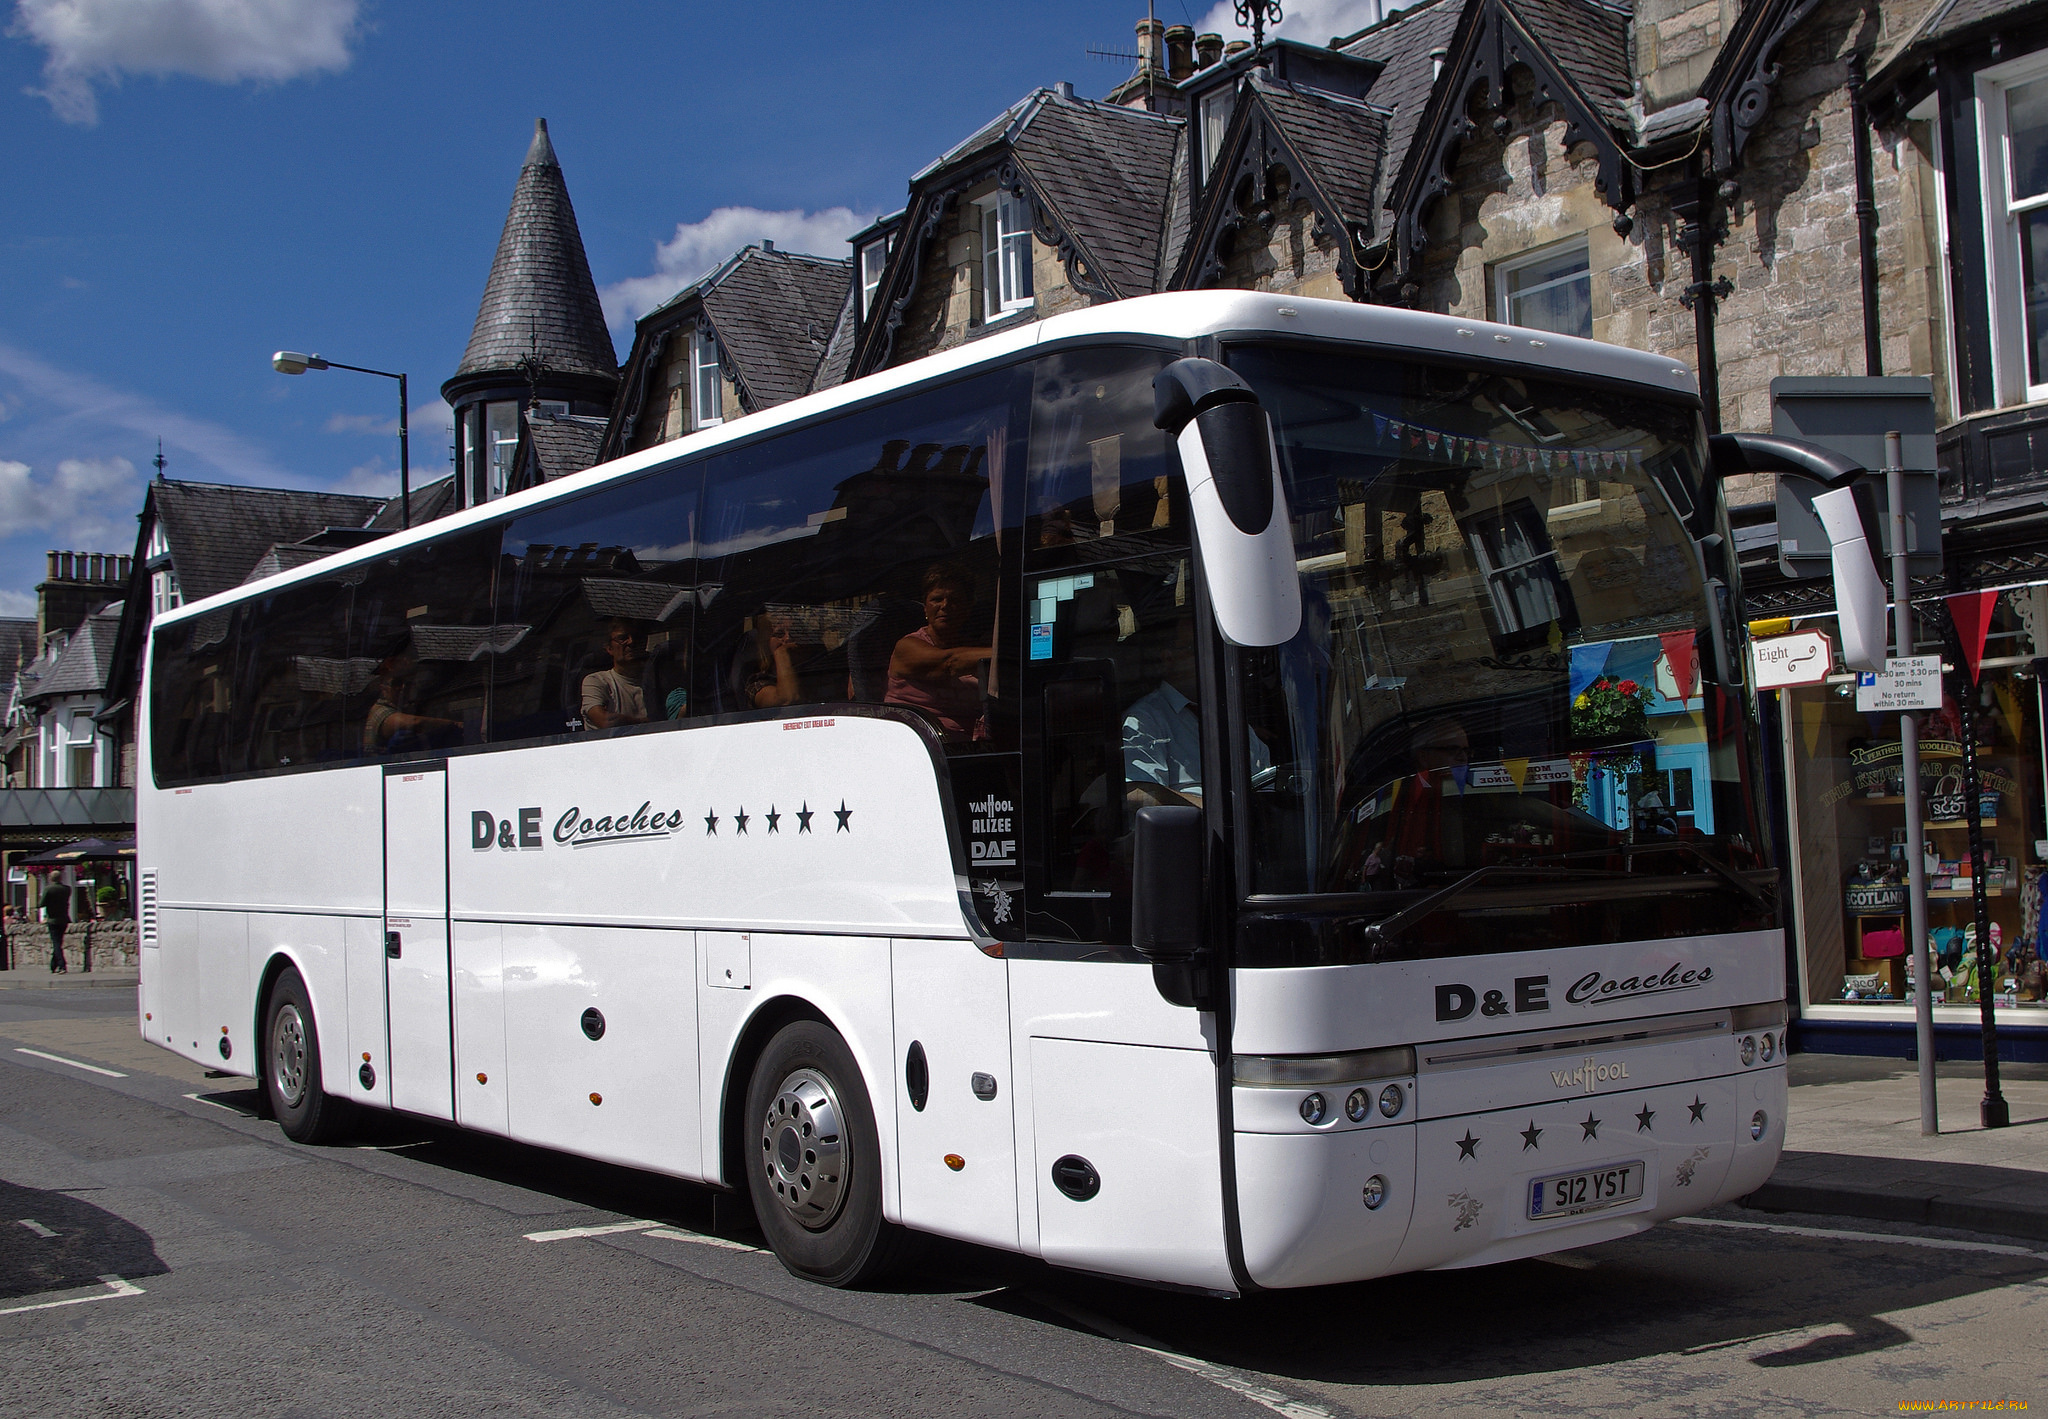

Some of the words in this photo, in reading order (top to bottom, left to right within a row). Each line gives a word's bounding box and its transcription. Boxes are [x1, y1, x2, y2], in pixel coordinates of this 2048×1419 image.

[1758, 646, 1789, 663] Eight
[1891, 660, 1907, 668] Mon
[1911, 659, 1924, 667] Sat
[1910, 668, 1927, 677] 5.30
[1928, 668, 1939, 677] pm
[1905, 679, 1922, 687] mins
[1873, 699, 1895, 708] within
[1896, 699, 1907, 707] 30
[1907, 698, 1925, 706] mins
[1893, 691, 1916, 699] return
[1866, 744, 1904, 761] PERTHSHI
[1918, 742, 1962, 754] WOOLLENS
[1819, 780, 1854, 808] THE
[1854, 762, 1943, 791] KNITAR
[1948, 764, 2018, 798] CNTRE
[471, 806, 543, 850] D&E
[552, 800, 684, 844] Coaches
[972, 818, 1012, 834] ALIZEE
[971, 840, 1016, 858] DAF
[1845, 890, 1904, 906] SCOTLAND
[1435, 975, 1550, 1022] D&E
[1565, 961, 1714, 1004] Coaches
[1593, 1168, 1630, 1199] YST
